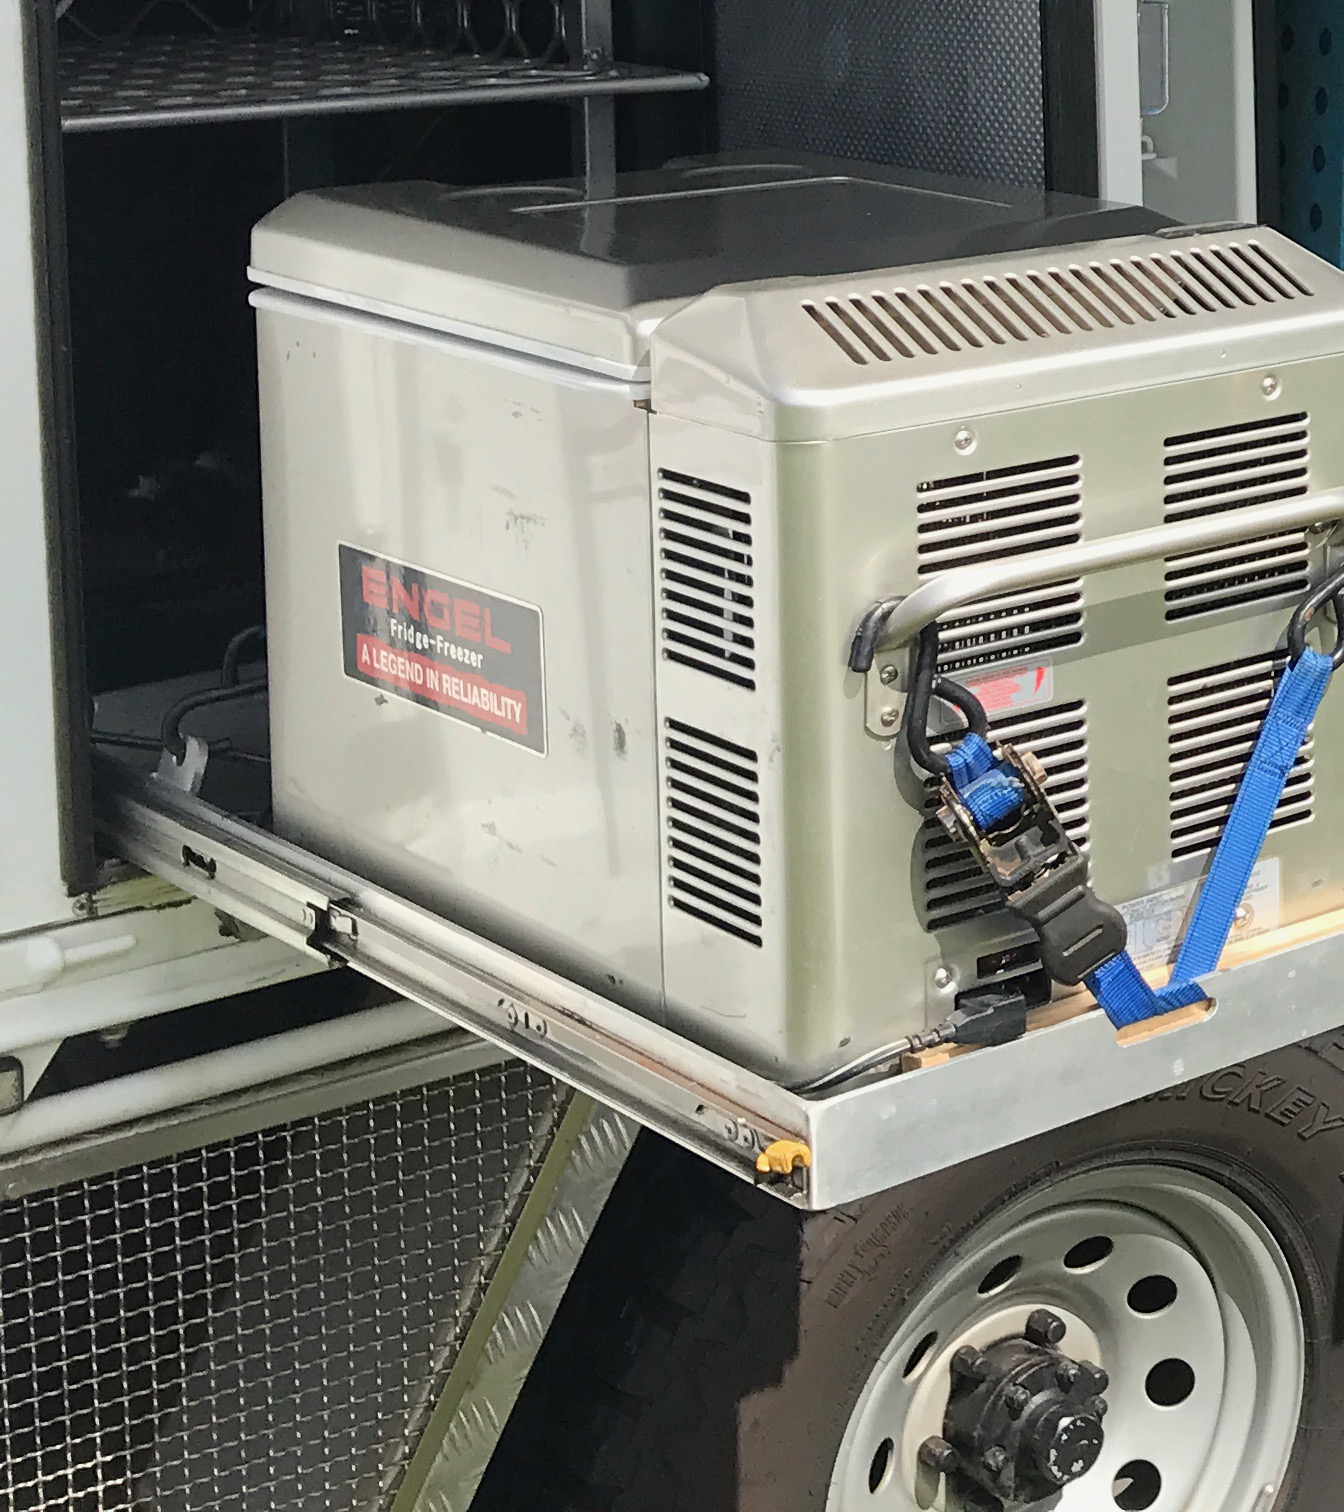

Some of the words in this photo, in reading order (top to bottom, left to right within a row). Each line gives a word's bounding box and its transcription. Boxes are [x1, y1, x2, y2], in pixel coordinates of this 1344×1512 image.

[361, 565, 512, 654] ENGEL
[390, 619, 485, 669] Fridge-Freezer
[361, 643, 371, 665] A
[373, 647, 424, 686] LEGEND
[426, 667, 440, 693] IN
[442, 672, 523, 724] RELIABILITY
